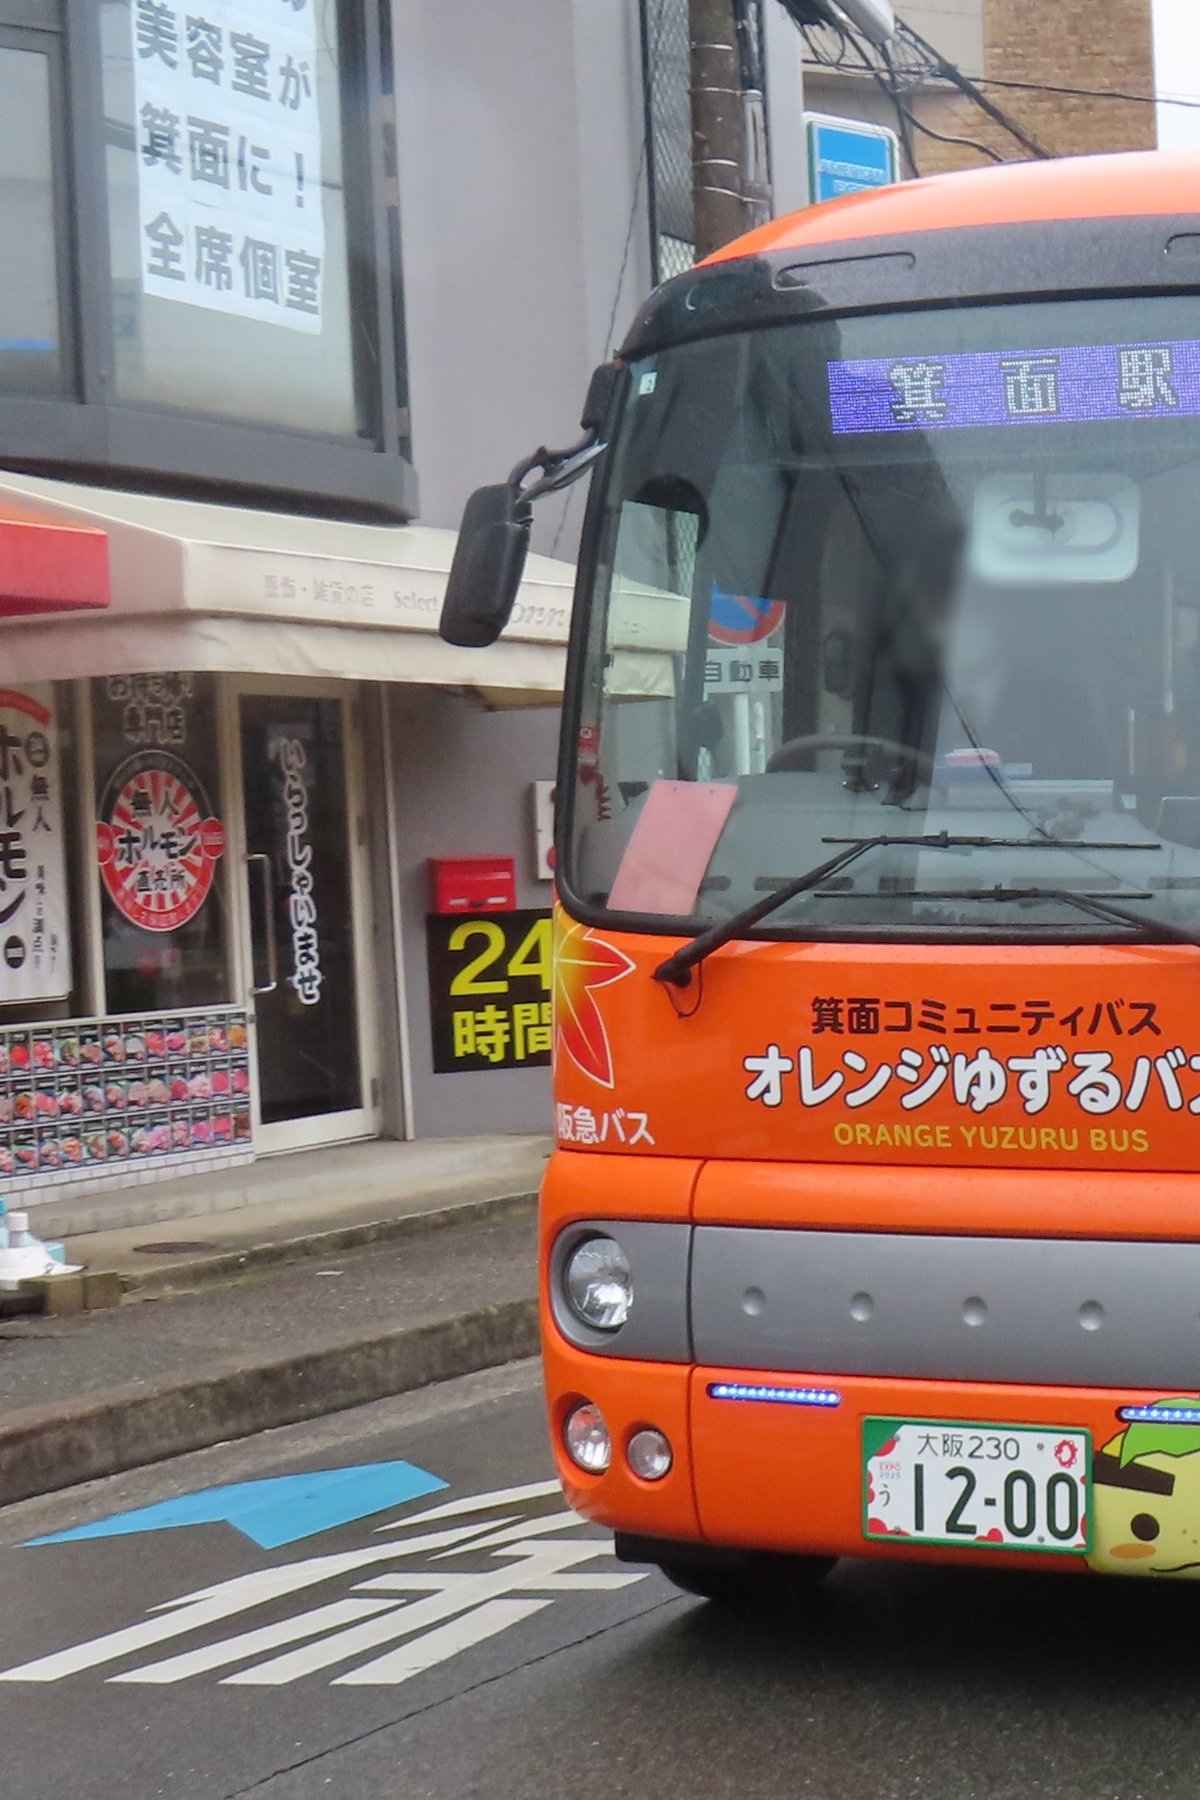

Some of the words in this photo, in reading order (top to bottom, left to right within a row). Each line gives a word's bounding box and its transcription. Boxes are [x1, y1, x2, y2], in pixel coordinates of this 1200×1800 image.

[136, 0, 311, 111] 美容室が
[144, 211, 321, 315] 全席個室
[888, 348, 1177, 421] 箕面駅
[705, 659, 780, 682] 自動車
[117, 825, 199, 865] ホルモン
[448, 918, 553, 997] 24
[453, 1003, 553, 1063] 時間
[811, 996, 1162, 1036] 箕面コミュニティバス
[556, 1102, 656, 1146] 阪急バス
[834, 1121, 952, 1148] ORANGE
[959, 1126, 1079, 1152] YUZURU
[1089, 1127, 1150, 1153] BUS
[878, 1483, 892, 1508] う
[913, 1463, 1080, 1541] 12-00
